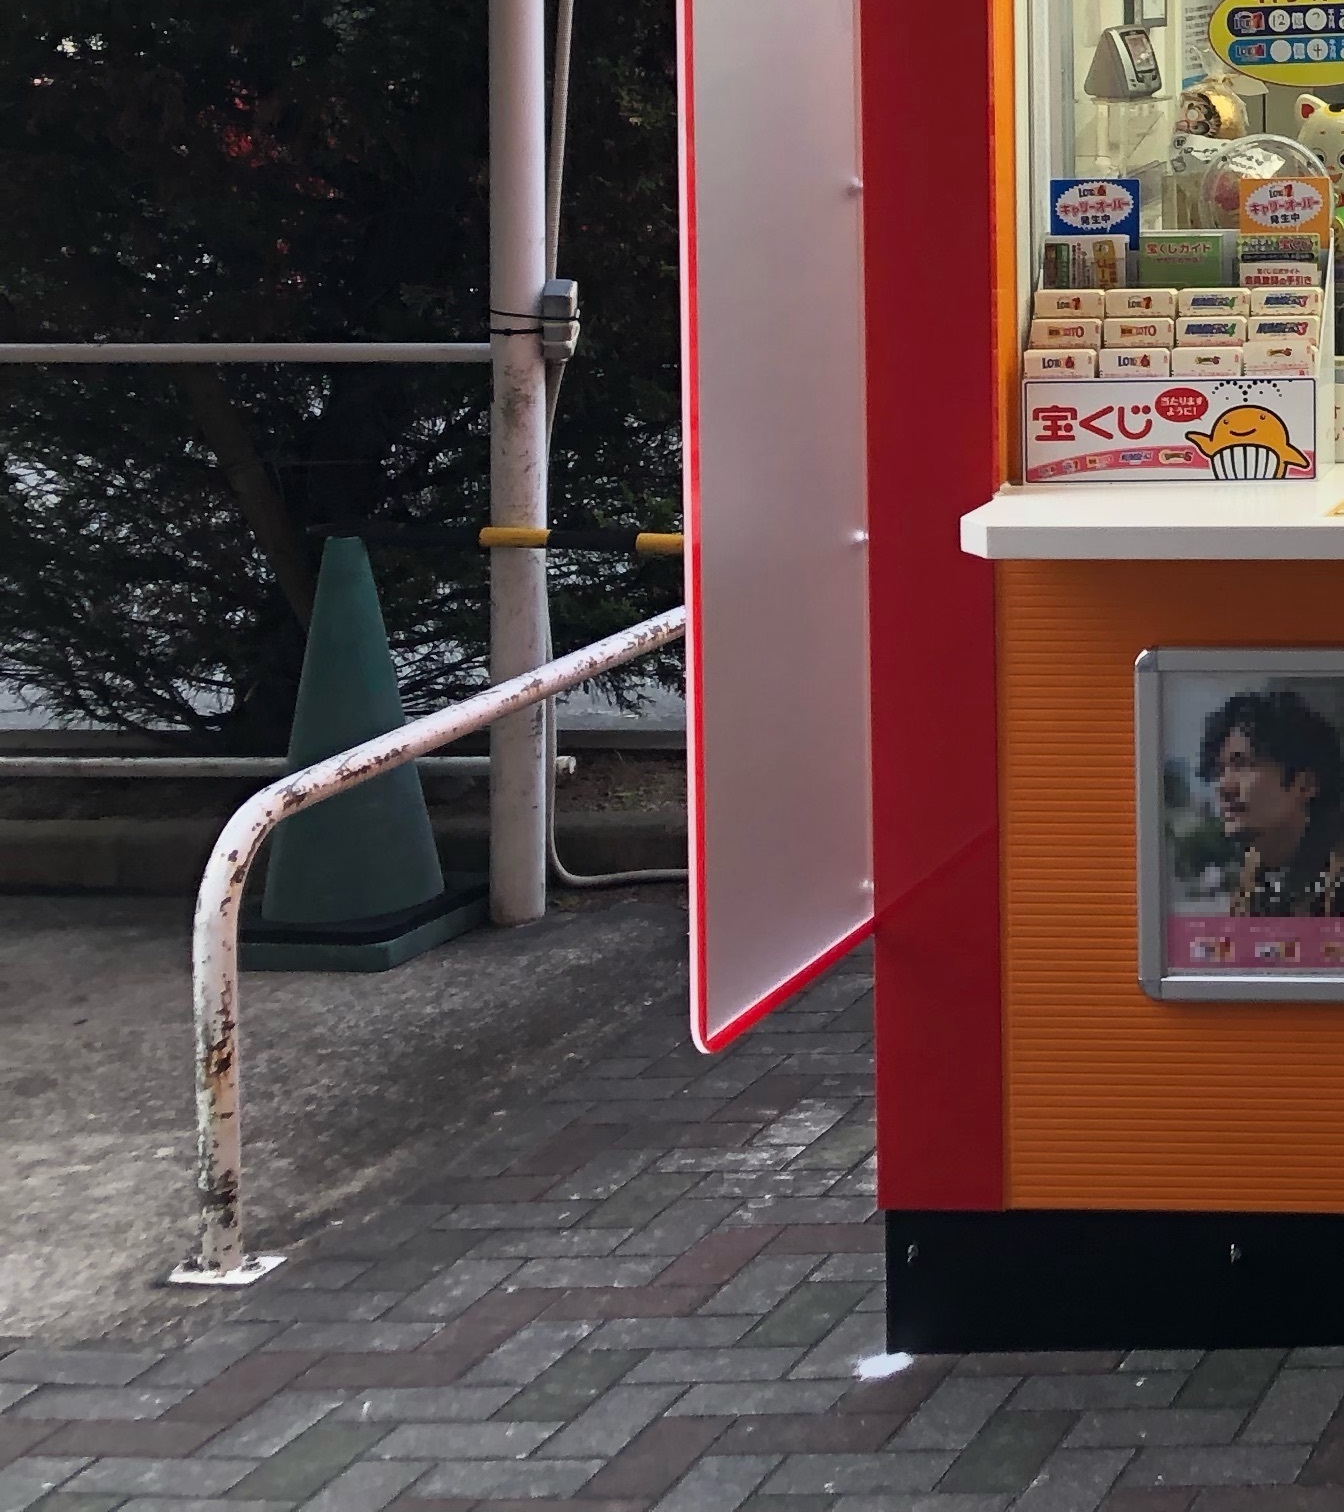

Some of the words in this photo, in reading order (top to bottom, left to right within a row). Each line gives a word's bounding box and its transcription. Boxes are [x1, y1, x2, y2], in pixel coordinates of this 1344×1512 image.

[1059, 200, 1131, 216] キャリーオーバー
[1249, 199, 1321, 215] キャリーオーバー
[1080, 214, 1112, 226] 発生中
[1270, 213, 1301, 225] 発生中
[1033, 404, 1153, 442] 宝くじ
